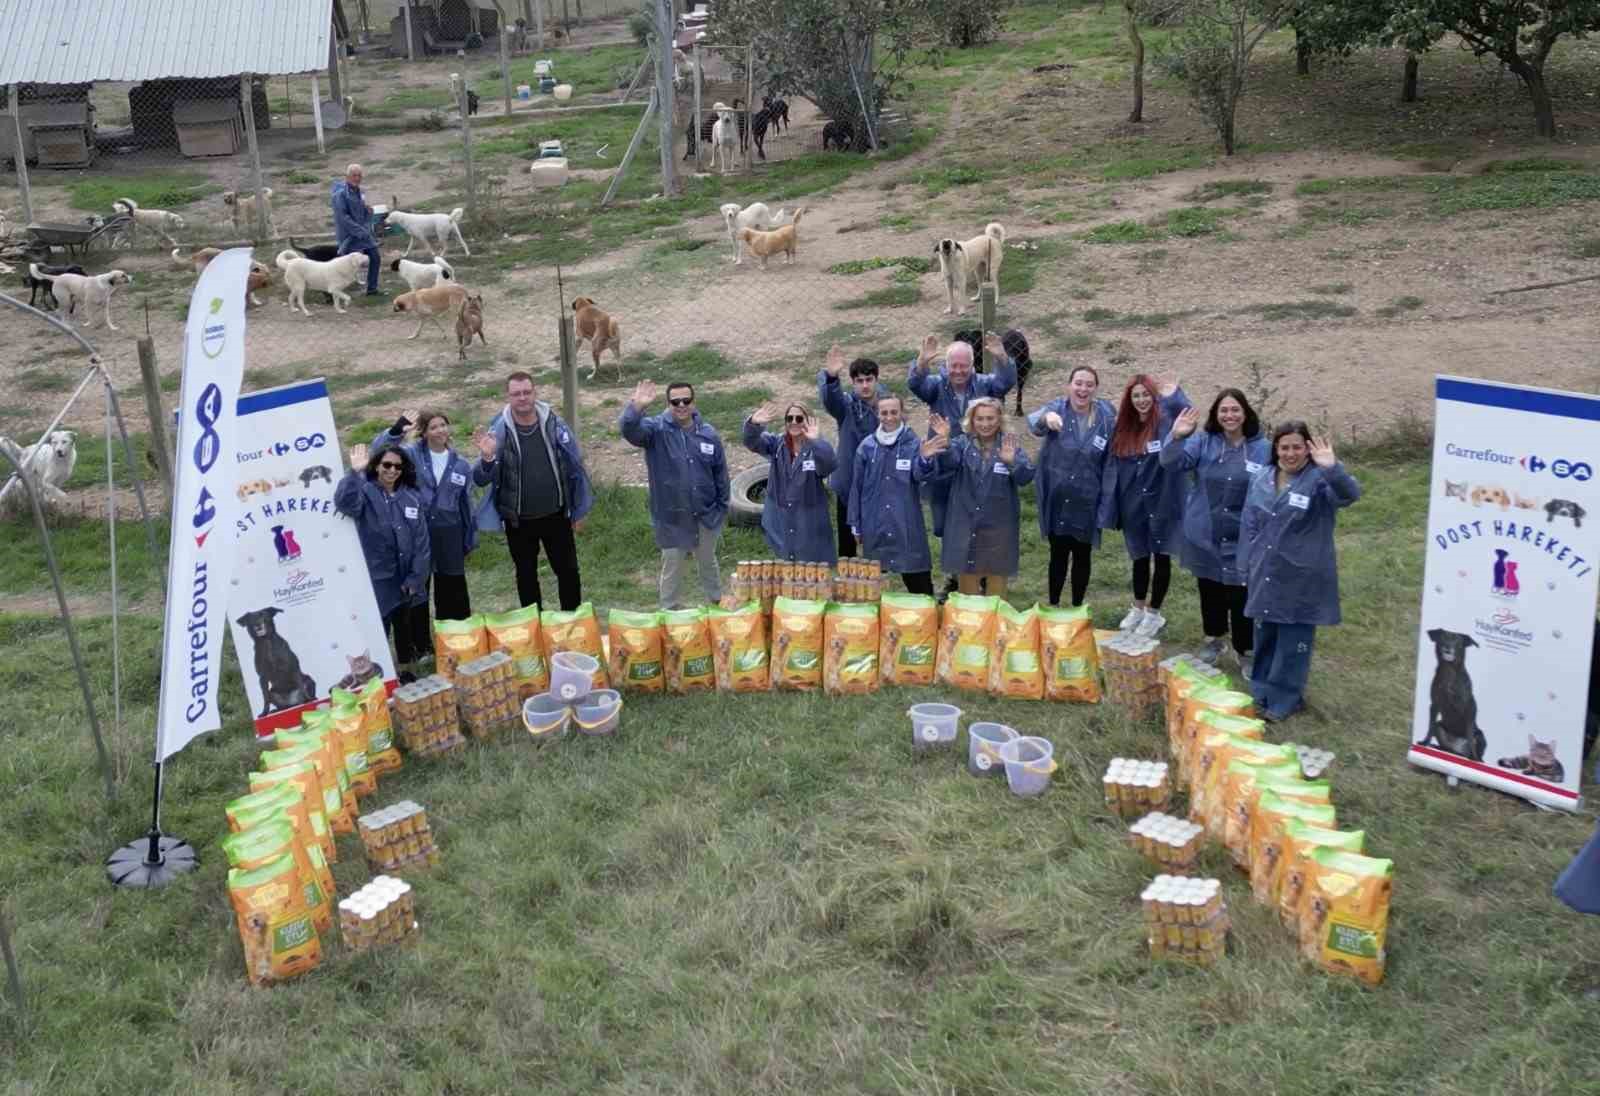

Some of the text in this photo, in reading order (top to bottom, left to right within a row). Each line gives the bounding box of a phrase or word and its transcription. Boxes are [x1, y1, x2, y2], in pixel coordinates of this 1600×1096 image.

[1445, 443, 1515, 465] Carrefour
[236, 497, 346, 538] ST HAREKE
[1435, 520, 1482, 550] DOST
[186, 562, 208, 723] Carrefour
